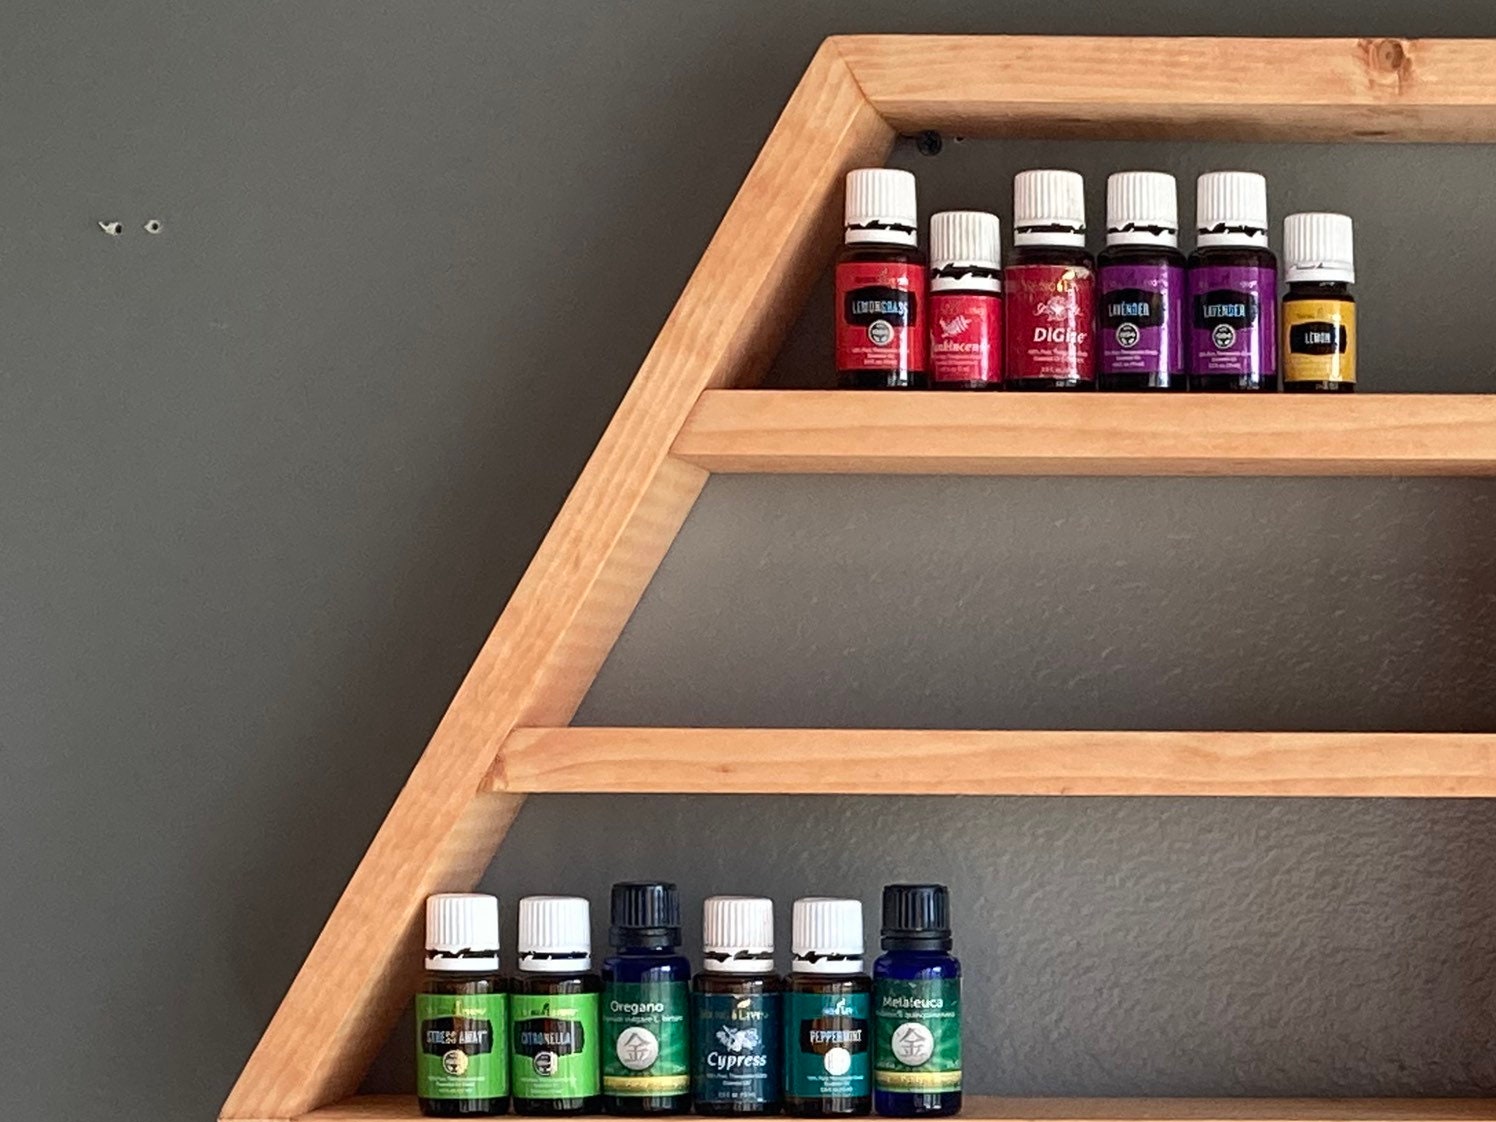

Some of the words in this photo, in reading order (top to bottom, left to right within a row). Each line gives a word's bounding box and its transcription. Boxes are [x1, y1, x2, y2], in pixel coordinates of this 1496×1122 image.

[1108, 302, 1150, 317] LAVENDER
[1203, 303, 1246, 318] LAVENDER
[1304, 332, 1331, 344] LEMON
[610, 1000, 665, 1015] Oregano
[882, 996, 944, 1008] Melaleuca
[809, 1029, 862, 1044] PEPPERMINT
[707, 1051, 767, 1070] Cypress
